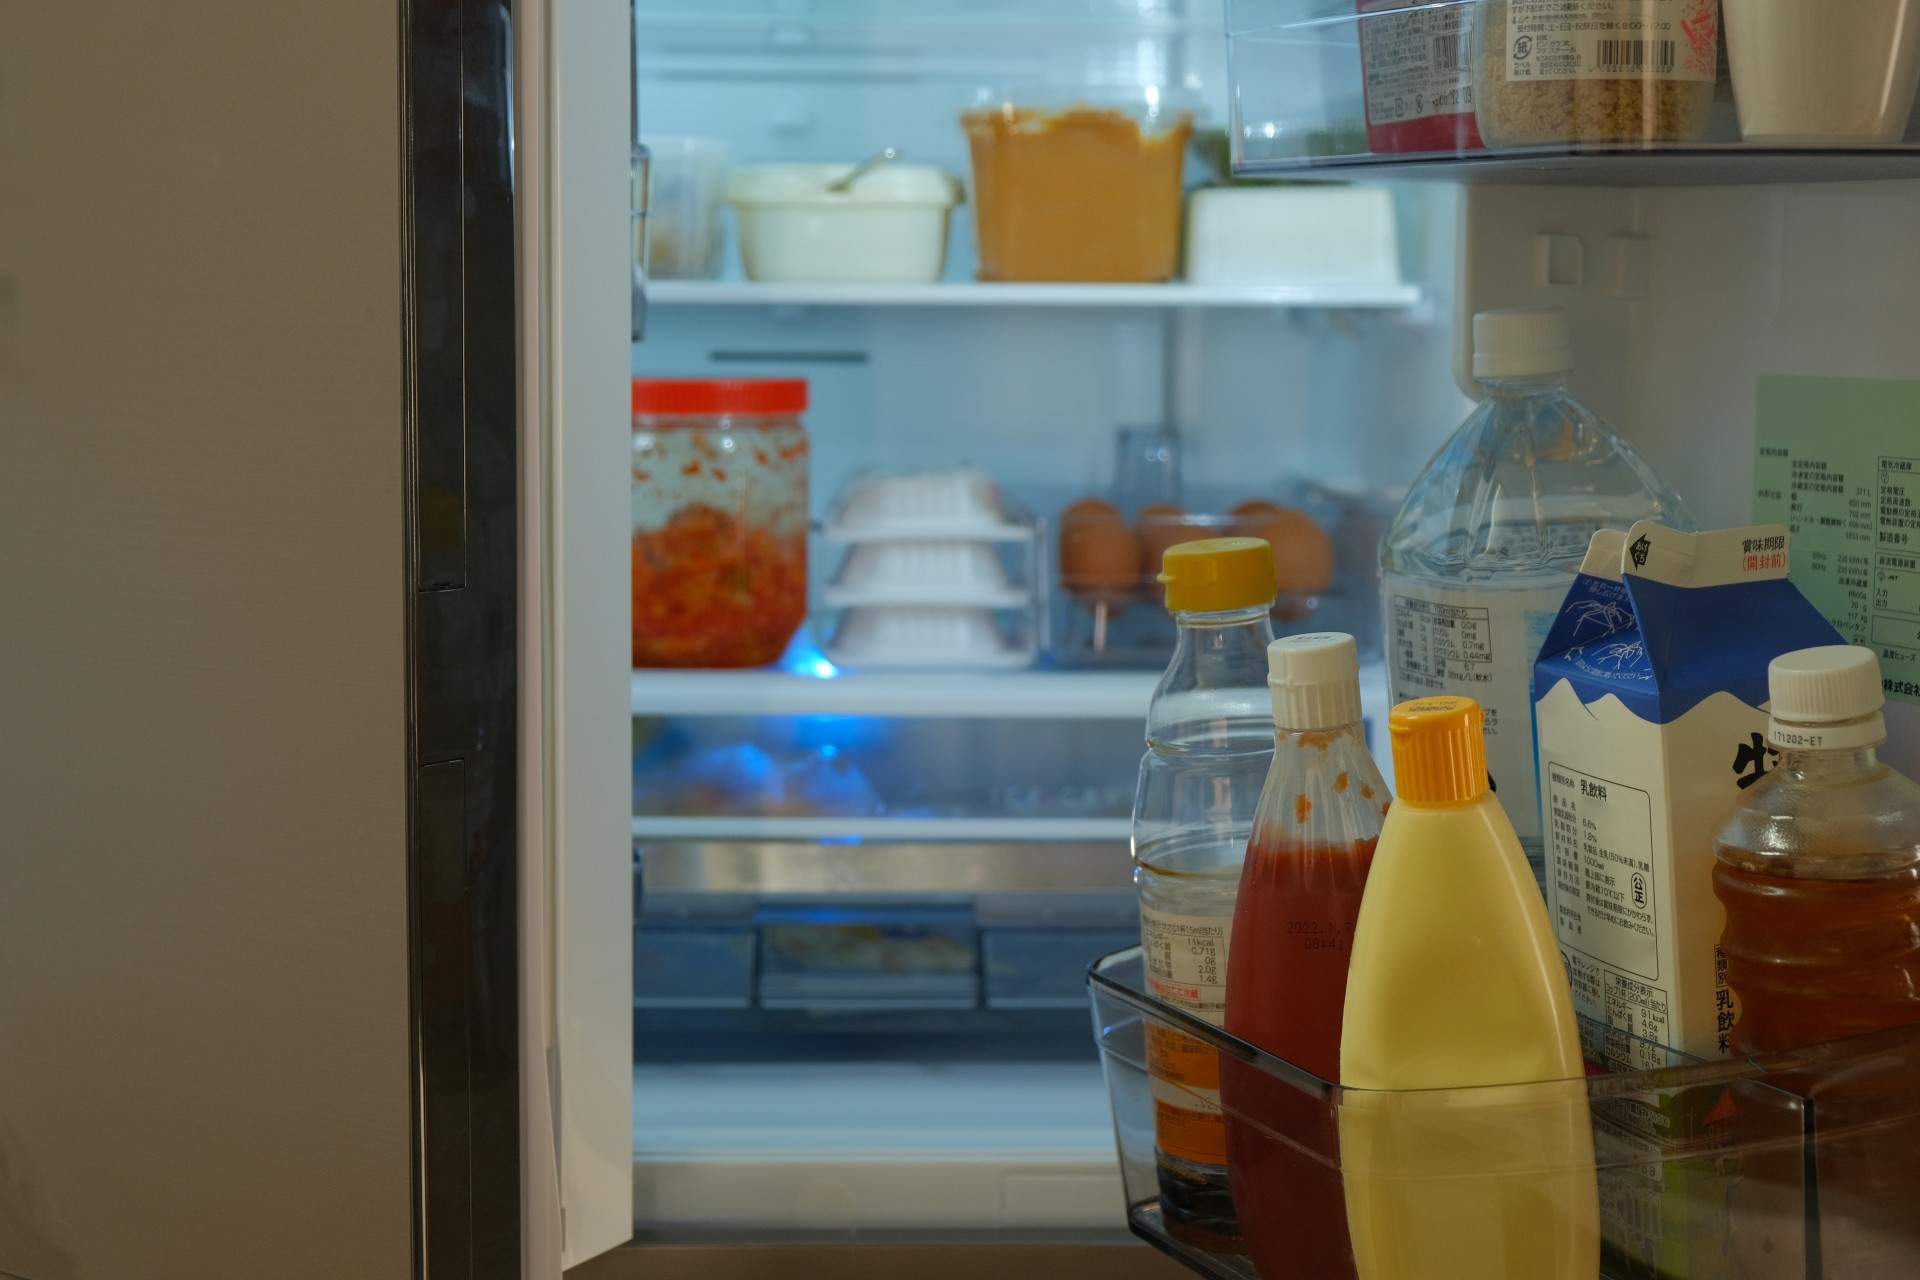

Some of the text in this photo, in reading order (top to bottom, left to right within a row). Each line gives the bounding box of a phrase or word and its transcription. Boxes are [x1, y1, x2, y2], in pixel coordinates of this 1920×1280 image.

[1743, 536, 1785, 554] 賞味期限
[1880, 531, 1908, 545] 製造番号
[1743, 552, 1786, 573] (開封前)
[1876, 588, 1888, 598] 入力
[1875, 599, 1888, 608] 出力
[1774, 731, 1823, 746] 171202-ET
[1732, 732, 1779, 790] 生
[1581, 779, 1607, 802] 乳飲料
[1191, 948, 1216, 957] 0.71g
[1205, 957, 1216, 966] 0g
[1198, 966, 1216, 976] 2.0g
[1200, 975, 1218, 985] 1.4g
[1615, 976, 1654, 999] 栄養成分表示
[1607, 996, 1632, 1011] エネルギー
[1641, 1020, 1658, 1034] 4.6g
[1605, 1047, 1632, 1065] カルシウム
[1640, 1050, 1661, 1065] 0.16g
